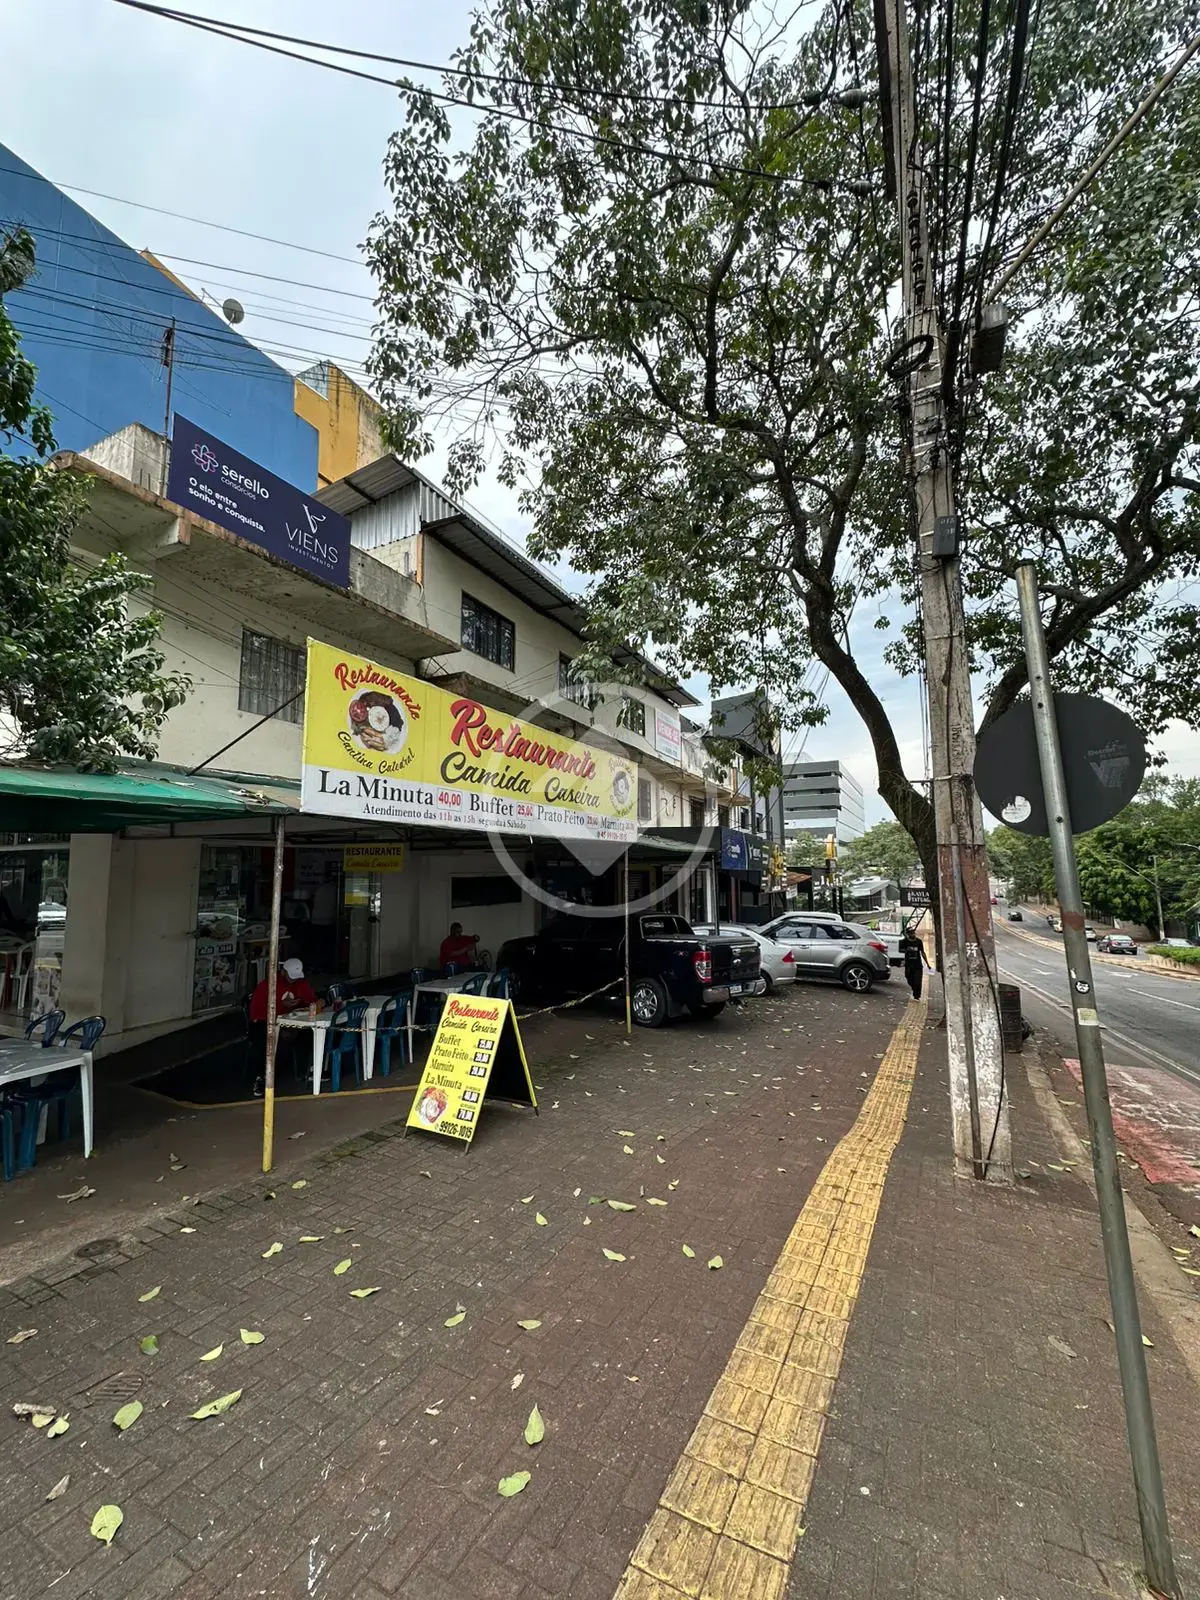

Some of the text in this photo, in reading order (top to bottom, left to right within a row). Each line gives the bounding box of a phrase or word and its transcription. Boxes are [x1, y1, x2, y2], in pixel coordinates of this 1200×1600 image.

[189, 477, 238, 509] O elo entre
[220, 476, 256, 500] consórcios
[221, 463, 270, 500] serello
[189, 487, 266, 533] sonho e conquista.
[285, 522, 339, 564] VIENS
[288, 543, 335, 570] INVESTIMENTOS
[334, 662, 423, 721] Restaurante
[337, 731, 374, 769] Cantina
[450, 698, 597, 780] Restaurante
[440, 751, 532, 794] Camida
[544, 776, 601, 809] Caseira
[318, 769, 351, 796] La
[356, 775, 434, 806] Minuta
[438, 791, 461, 806] 40,00
[469, 794, 515, 816] Buffet
[537, 804, 563, 823] Prato
[564, 809, 585, 826] Feito
[363, 803, 422, 819] Atendimento
[423, 808, 437, 820] das
[439, 811, 452, 822] 11h
[453, 815, 461, 823] as
[463, 814, 476, 824] 15h
[346, 847, 402, 857] RESTAURANTE
[447, 999, 500, 1021] Restaurante
[441, 1016, 498, 1035] Camida Caseira
[438, 1032, 462, 1047] Buffet
[429, 1058, 455, 1073] Marmita
[433, 1045, 453, 1059] Prato
[451, 1048, 469, 1062] Feito
[425, 1072, 435, 1085] La
[434, 1075, 463, 1090] Minuta
